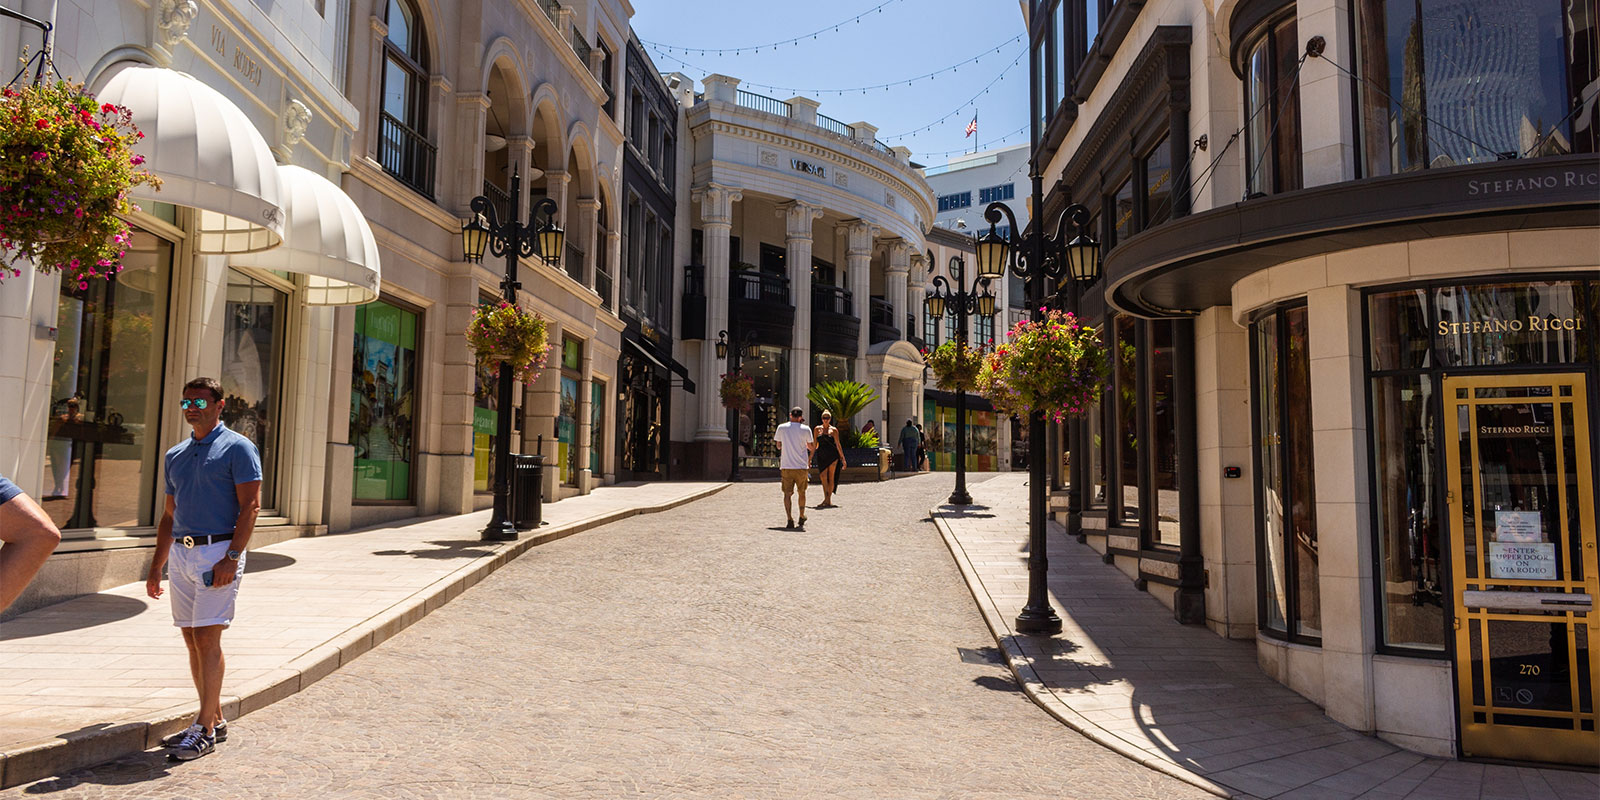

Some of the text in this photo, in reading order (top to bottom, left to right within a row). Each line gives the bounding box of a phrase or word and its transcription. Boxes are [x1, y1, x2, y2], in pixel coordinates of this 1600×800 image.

[211, 23, 262, 87] VIA RODEO
[1468, 176, 1558, 195] STEFANO
[1438, 315, 1582, 336] STEFANO RICCI
[1481, 425, 1550, 434] STEFANO RICCI
[1519, 664, 1541, 676] 270
